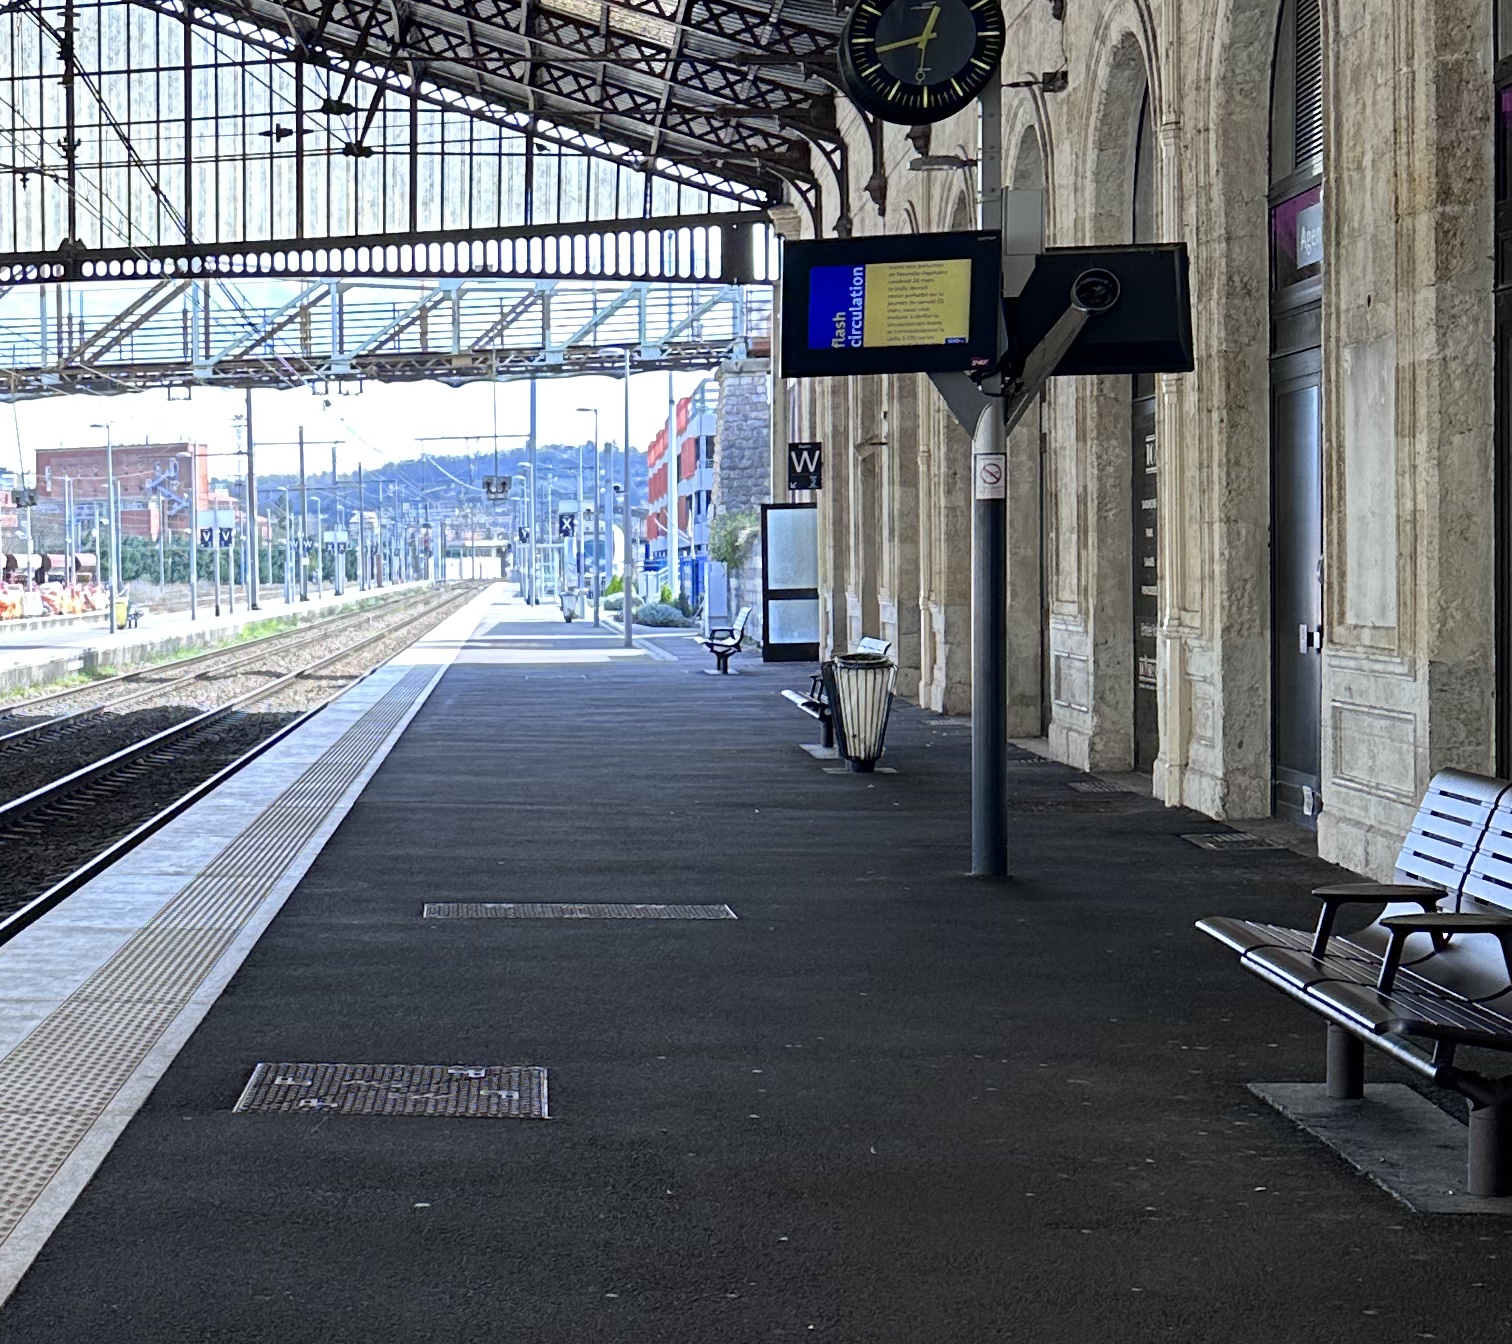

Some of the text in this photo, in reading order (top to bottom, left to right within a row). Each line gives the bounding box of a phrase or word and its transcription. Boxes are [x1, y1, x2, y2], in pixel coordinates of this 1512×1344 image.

[1300, 226, 1322, 256] Agen
[847, 266, 864, 348] circulation
[830, 311, 846, 348] flash
[791, 450, 820, 473] W
[562, 518, 572, 530] X
[202, 532, 211, 542] V
[222, 531, 230, 541] V
[303, 540, 312, 548] W
